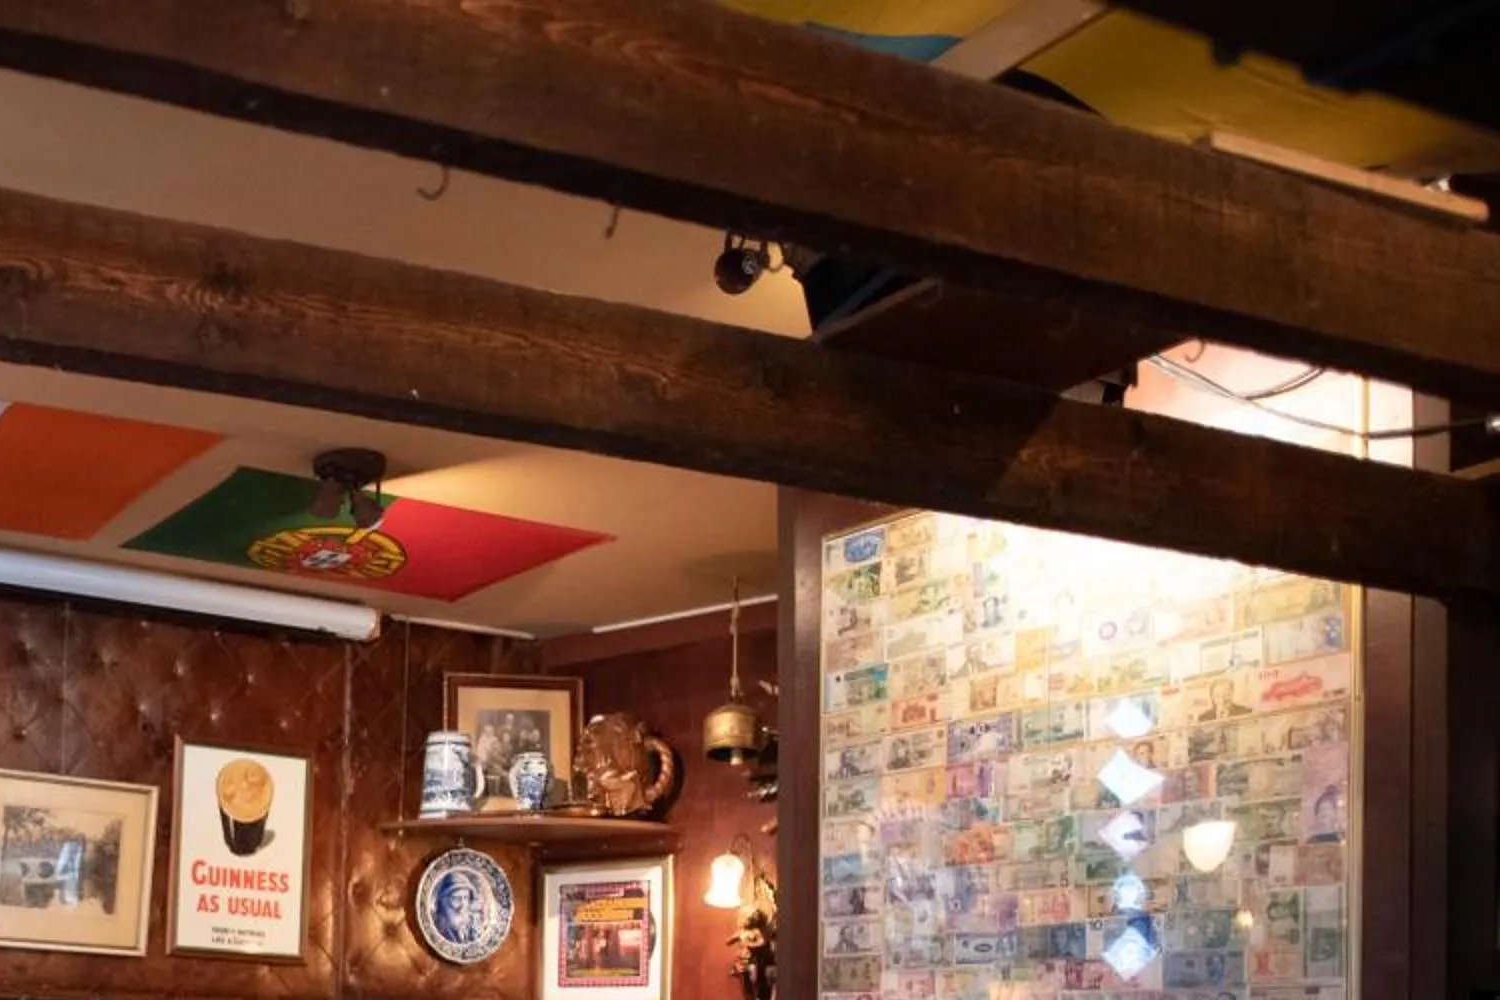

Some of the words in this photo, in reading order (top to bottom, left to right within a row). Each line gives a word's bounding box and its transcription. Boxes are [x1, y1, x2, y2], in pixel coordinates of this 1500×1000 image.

[191, 859, 290, 893] GUINNESS
[197, 894, 220, 913] AS
[227, 896, 283, 919] USUAL
